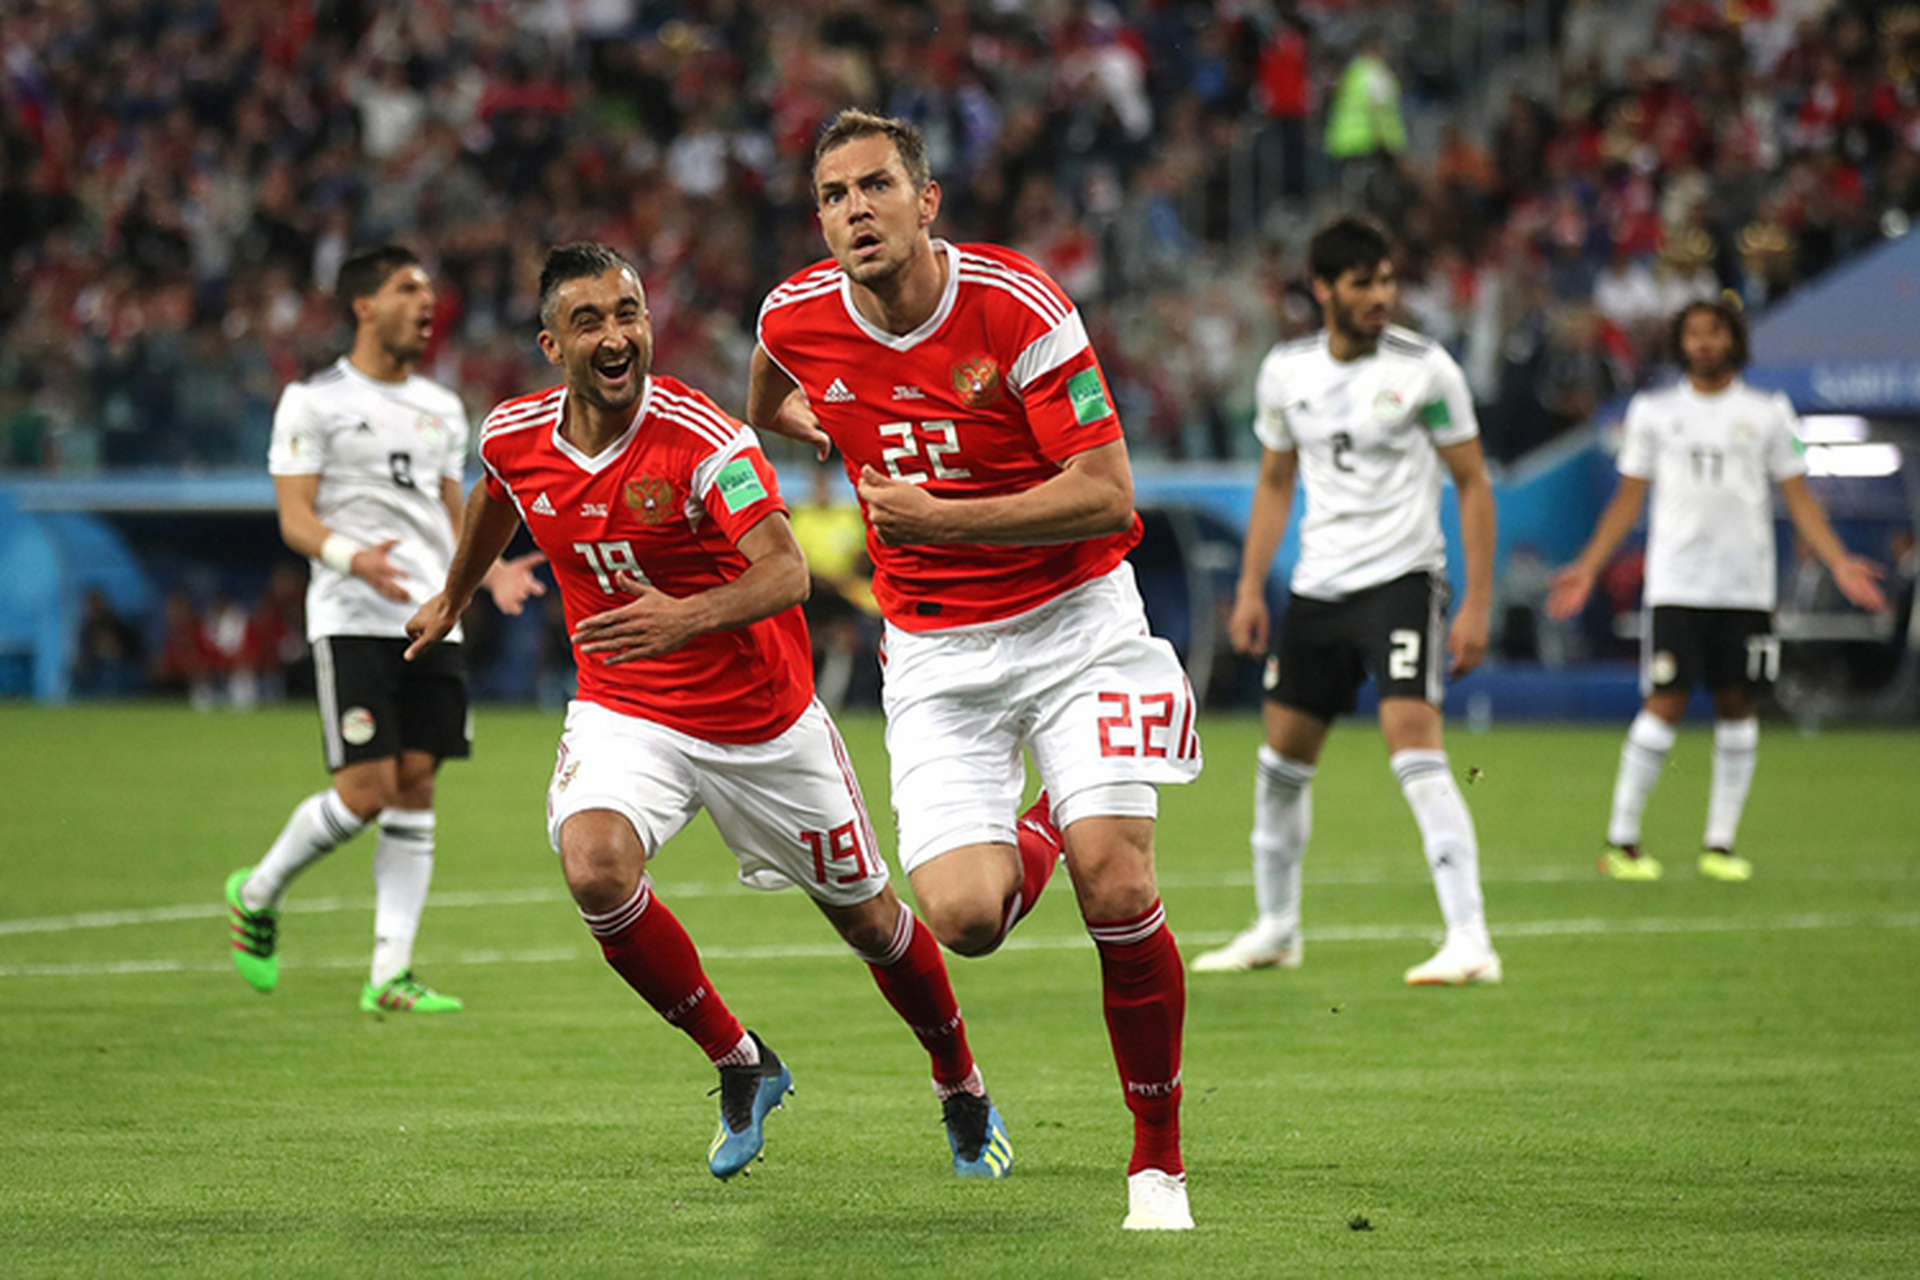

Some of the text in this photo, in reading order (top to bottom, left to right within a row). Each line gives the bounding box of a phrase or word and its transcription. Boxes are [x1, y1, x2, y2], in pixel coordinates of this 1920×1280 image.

[878, 419, 971, 485] 22
[1390, 629, 1420, 679] 2
[1098, 691, 1174, 757] 22
[801, 820, 867, 883] 19
